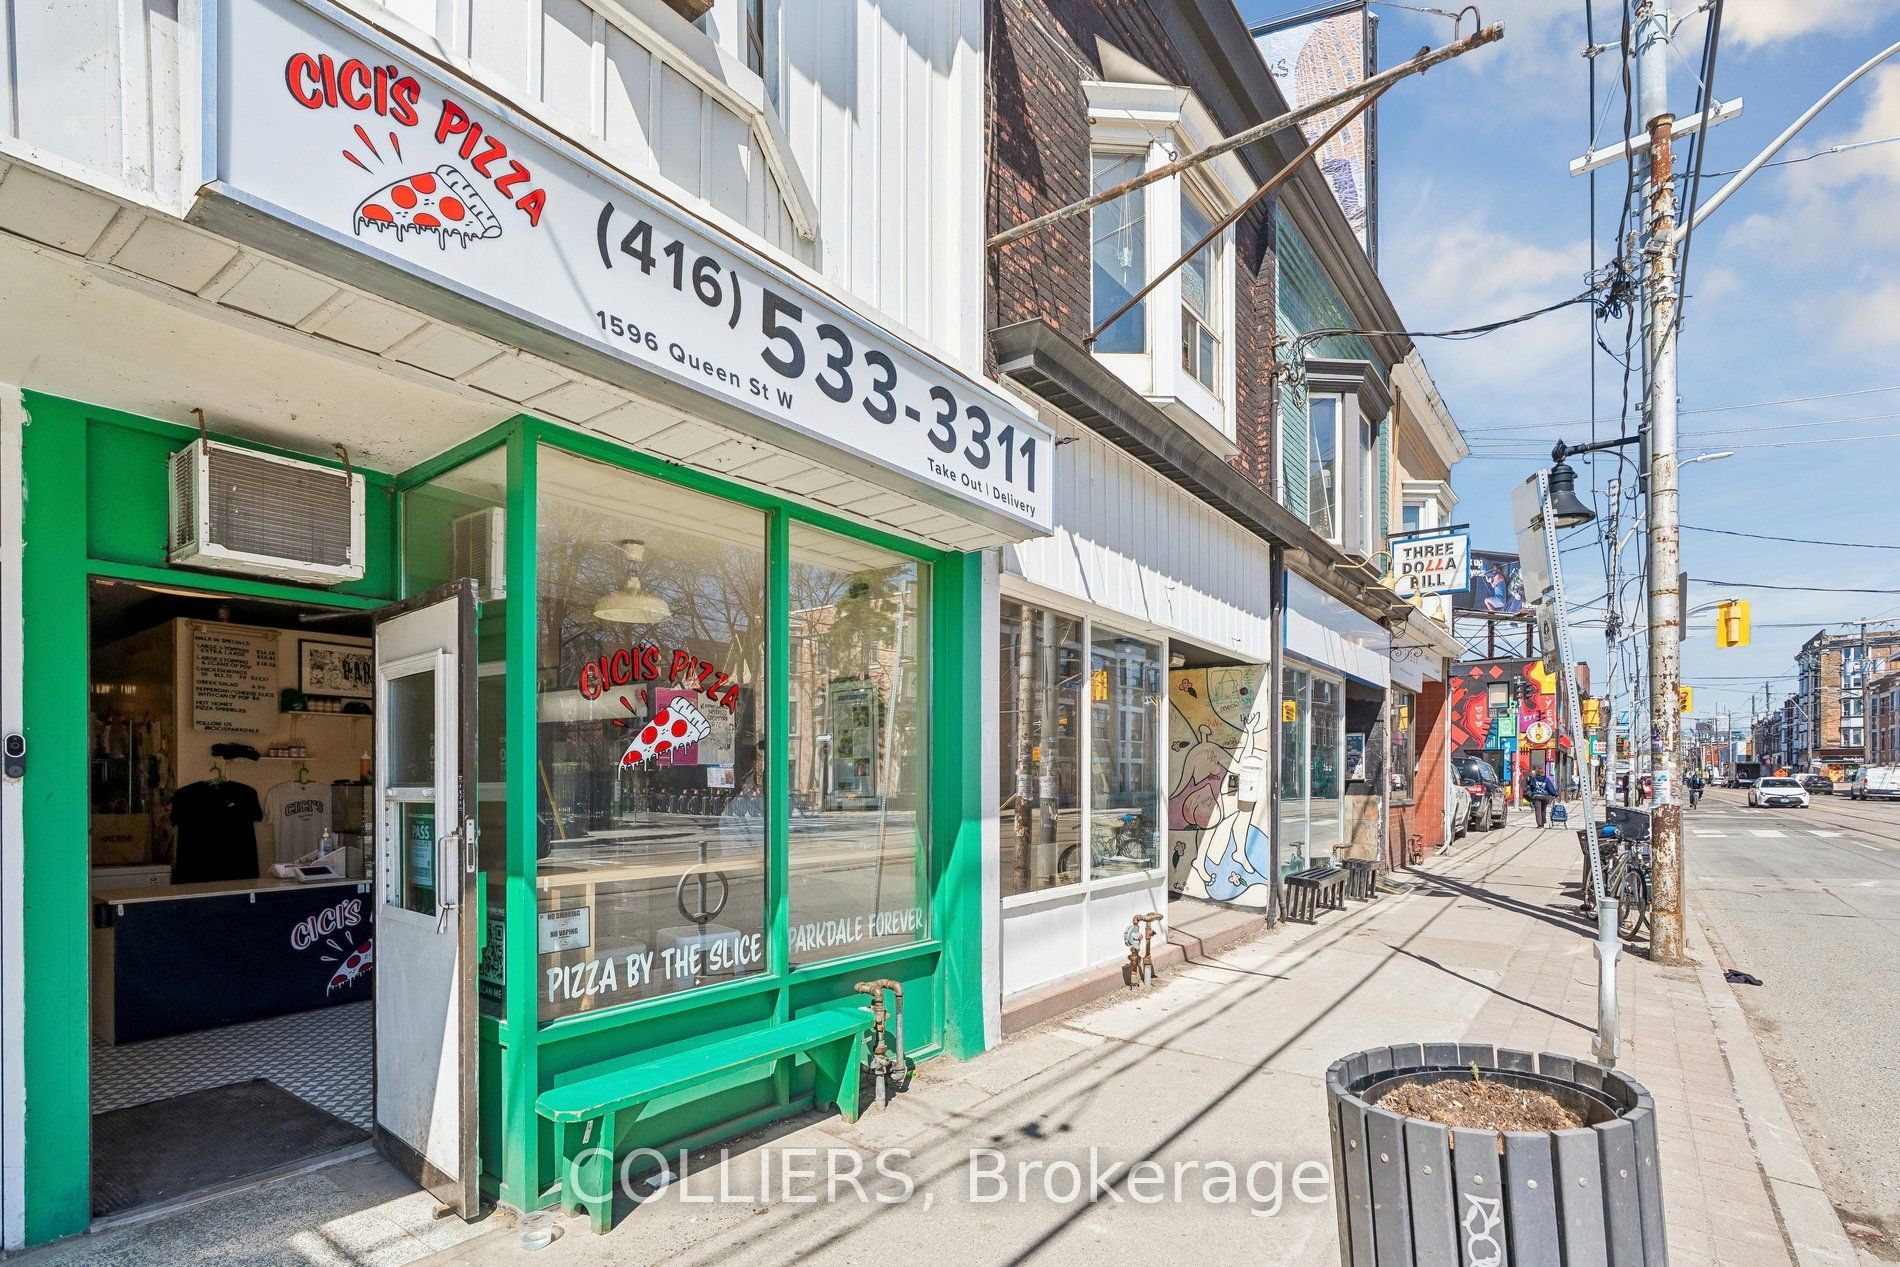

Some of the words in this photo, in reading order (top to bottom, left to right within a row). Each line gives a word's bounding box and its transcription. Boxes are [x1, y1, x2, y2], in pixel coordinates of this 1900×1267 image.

[285, 52, 420, 126] CICI'S
[435, 99, 546, 227] PIZZA
[596, 310, 659, 351] 1596
[669, 342, 740, 388] Queen
[749, 376, 769, 398] St
[777, 392, 794, 410] W
[597, 201, 741, 330] (416)
[761, 287, 1036, 493] 533-3311
[926, 456, 957, 482] Take
[961, 473, 983, 493] Out
[993, 486, 1036, 518] Delivery
[1402, 557, 1456, 575] DOLLA
[1403, 542, 1454, 558] THREE
[221, 638, 250, 646] SPECIALS
[580, 642, 659, 700] CICI'S
[670, 649, 741, 715] PIZZA
[285, 799, 324, 816] CICI'S
[411, 824, 430, 840] PASS
[290, 899, 361, 950] CICI'S
[550, 930, 559, 938] NO
[559, 927, 578, 937] VAPING
[556, 910, 581, 920] SMOKING
[788, 916, 863, 954] PARKDALE
[868, 905, 923, 940] FOREVER
[547, 955, 618, 1003] PIZZA
[627, 949, 651, 985] BY
[661, 942, 702, 975] THE
[709, 932, 762, 972] SLICE
